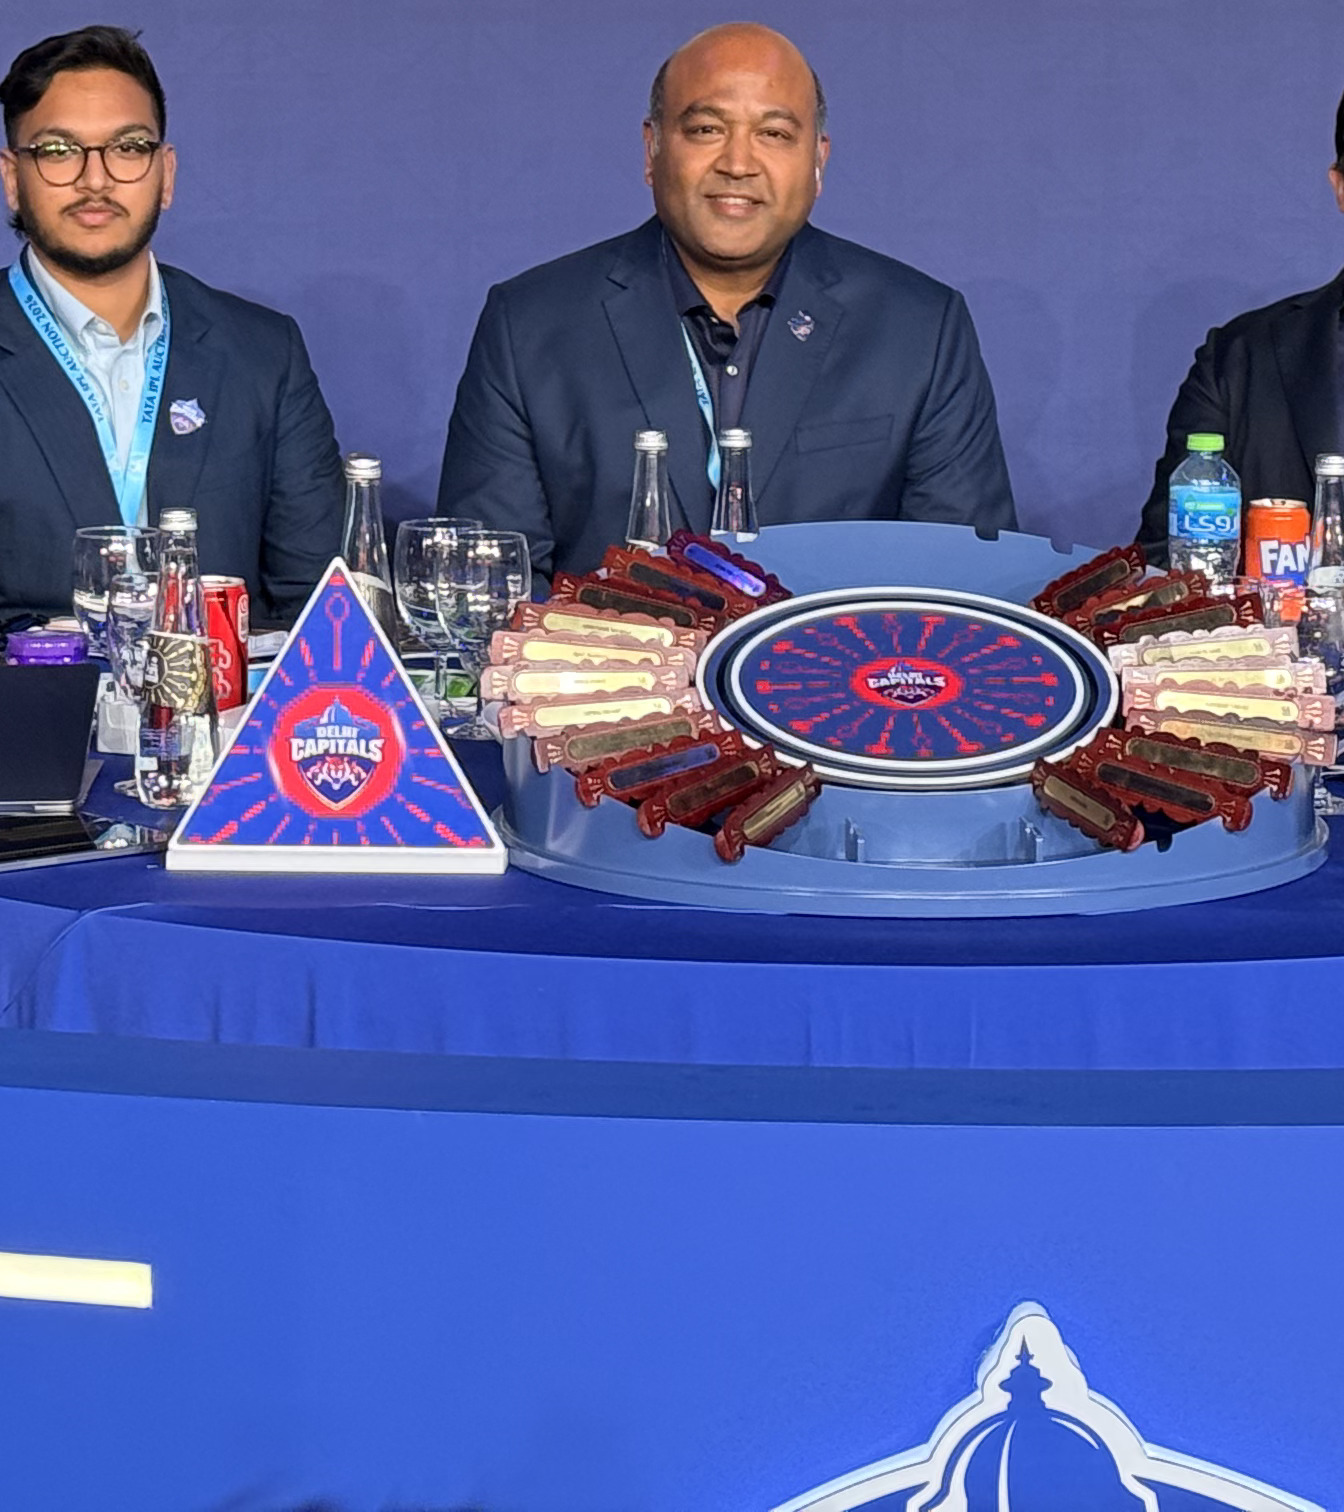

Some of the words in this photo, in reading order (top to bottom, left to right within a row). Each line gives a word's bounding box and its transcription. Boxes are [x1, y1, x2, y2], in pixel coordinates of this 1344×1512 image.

[41, 319, 80, 374] AUCTION
[141, 396, 157, 424] TATA
[316, 725, 360, 738] DELHI
[289, 738, 386, 763] CAPITALS
